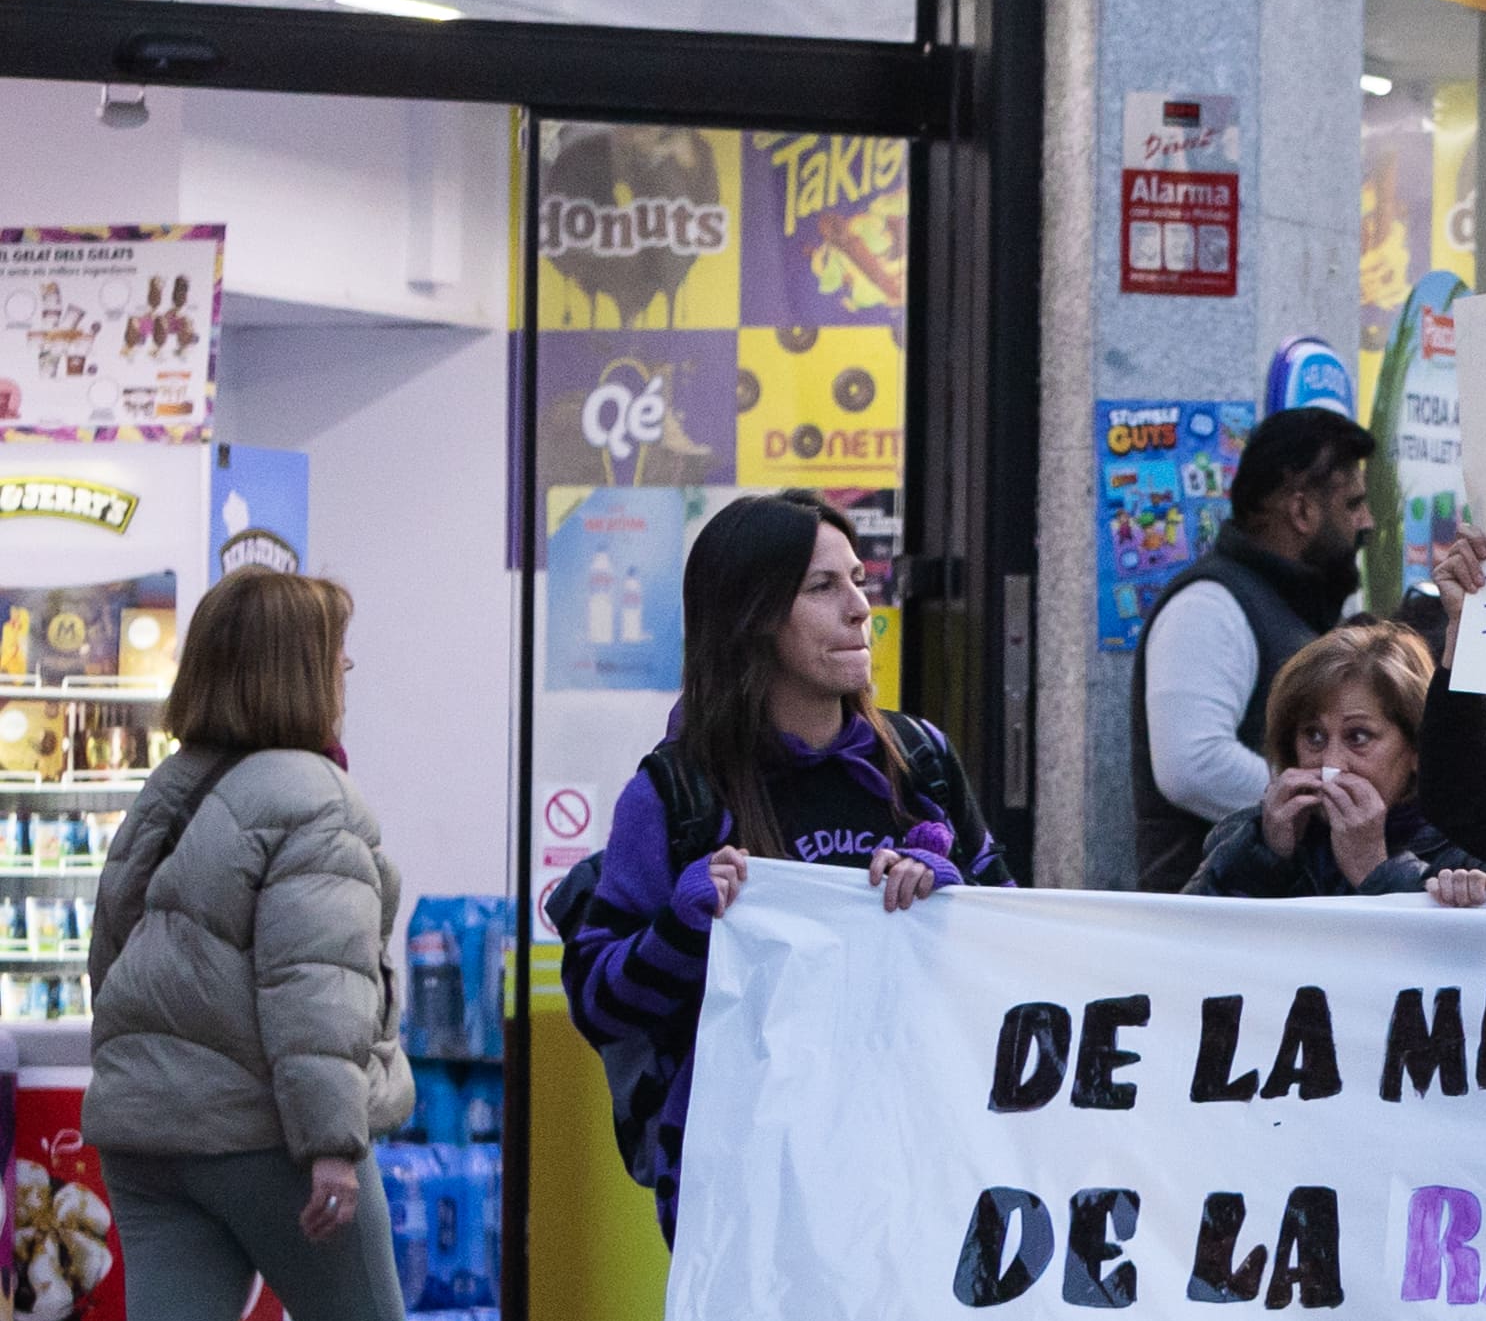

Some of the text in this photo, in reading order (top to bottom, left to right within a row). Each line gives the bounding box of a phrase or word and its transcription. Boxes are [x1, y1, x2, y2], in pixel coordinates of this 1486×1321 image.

[1130, 176, 1230, 206] Alarma
[1107, 424, 1177, 455] GUYS
[987, 994, 1150, 1113] DE
[1190, 986, 1343, 1103] LA
[953, 1187, 1140, 1307] DE
[1187, 1185, 1346, 1311] LA
